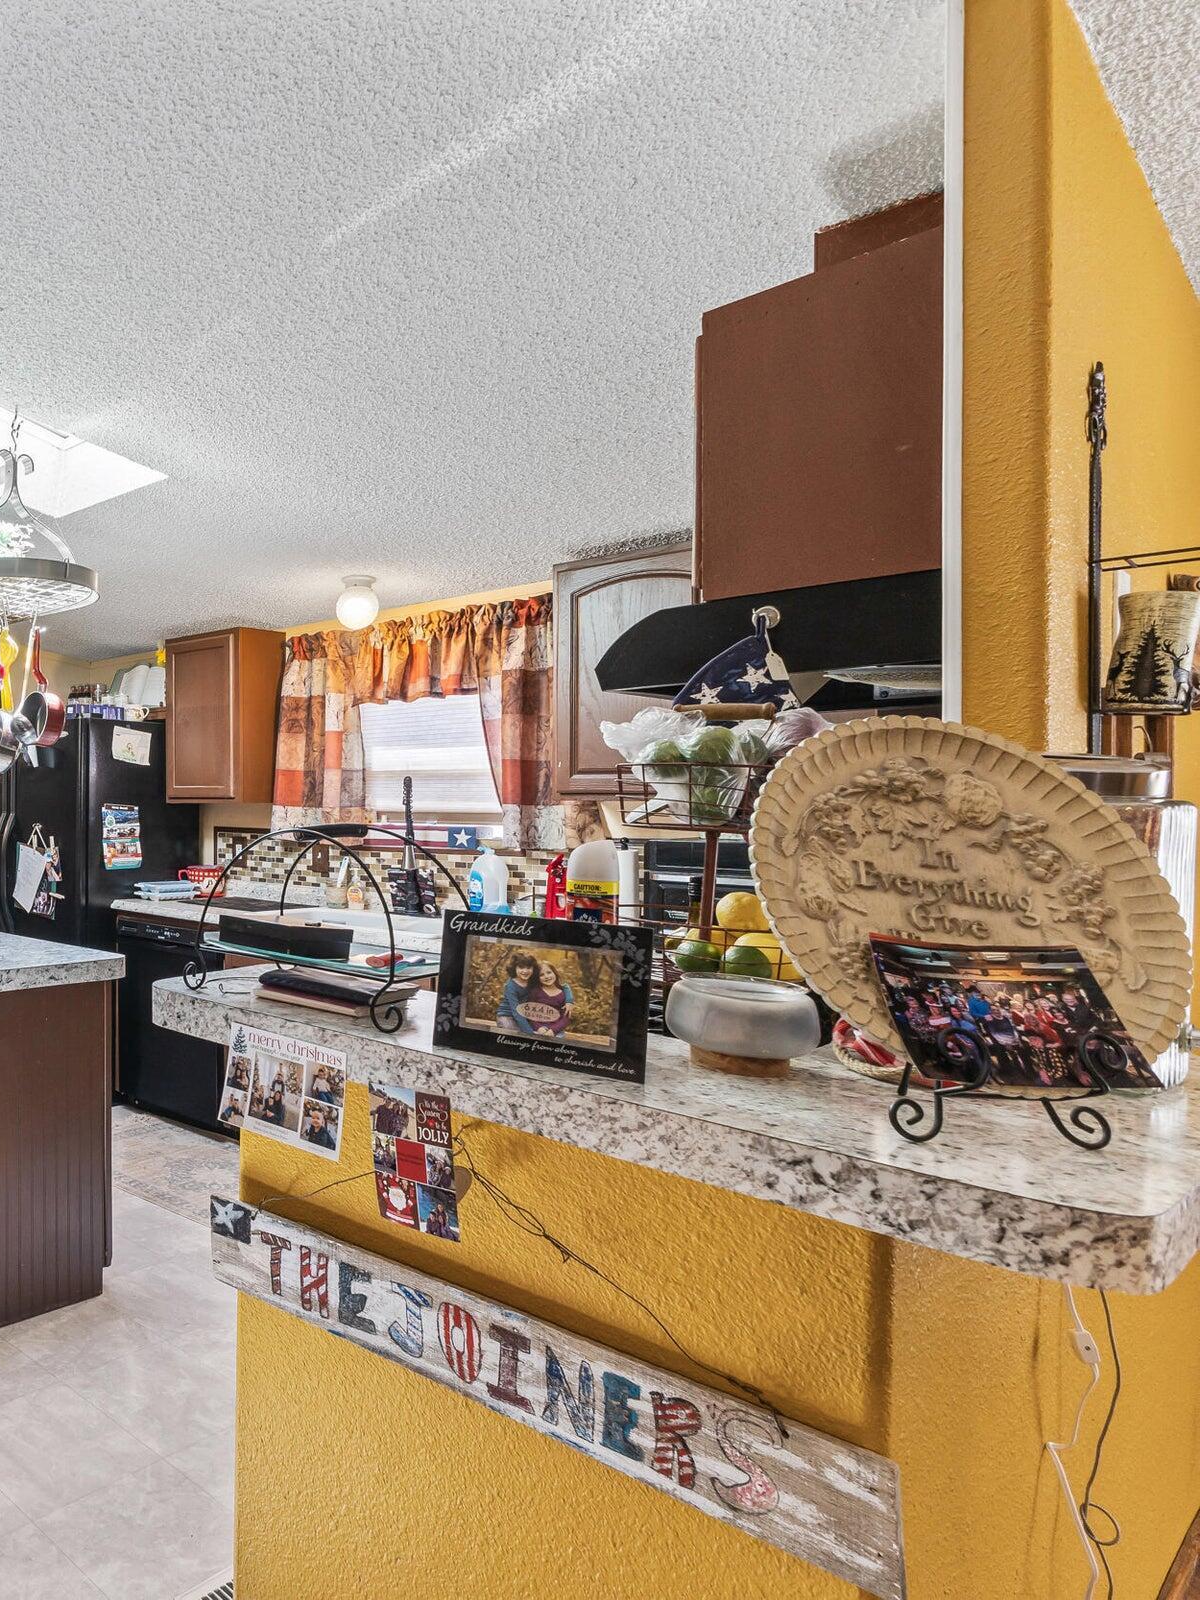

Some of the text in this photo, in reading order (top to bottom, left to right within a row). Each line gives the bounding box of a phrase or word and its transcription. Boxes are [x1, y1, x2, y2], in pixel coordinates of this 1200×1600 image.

[919, 837, 960, 872] In
[573, 883, 602, 892] CAUTION:
[851, 859, 1041, 928] Everything
[450, 913, 535, 936] Grandkids
[907, 903, 991, 939] Give
[248, 1031, 343, 1066] merry christmas
[531, 1041, 553, 1051] from
[564, 1056, 595, 1068] cherish
[596, 1062, 616, 1072] and
[417, 1126, 450, 1145] JOLLY
